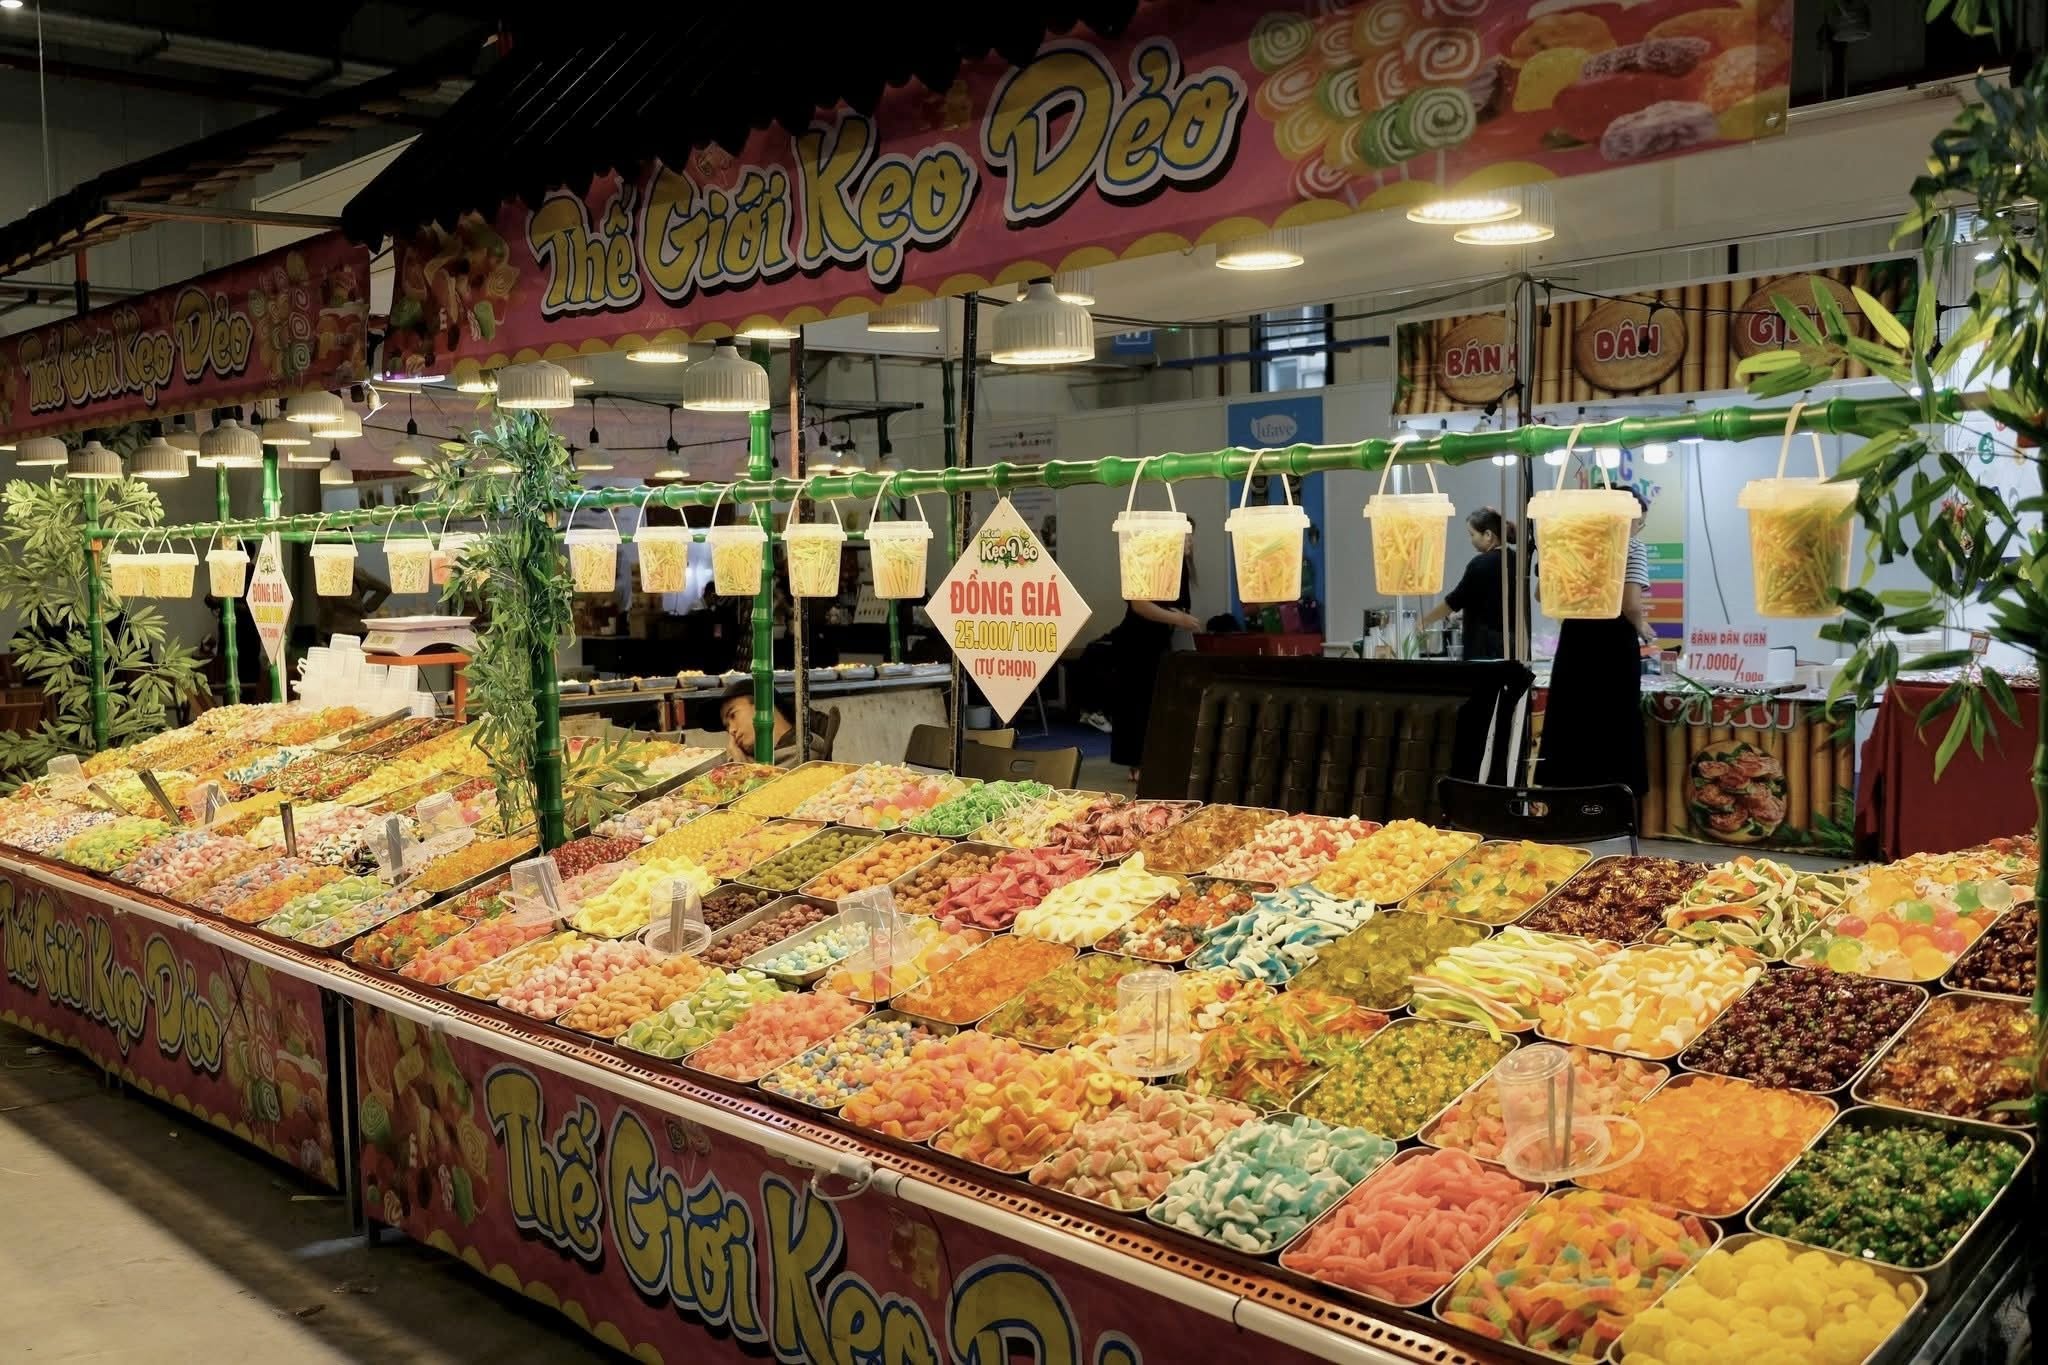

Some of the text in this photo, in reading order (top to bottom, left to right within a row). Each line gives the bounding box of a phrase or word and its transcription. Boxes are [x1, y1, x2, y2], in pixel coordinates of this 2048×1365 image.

[638, 158, 796, 302] Giới
[790, 112, 978, 286] Kẹo
[980, 36, 1248, 222] Dẻo
[174, 285, 254, 380] Dẻo
[1594, 318, 1660, 362] DÂN
[980, 535, 1039, 564] Kẹo Dẻo
[950, 569, 1061, 617] ĐỒNG GIÁ
[955, 619, 1057, 652] 25.000/100G
[974, 657, 1037, 681] (TỰ CHỌN)
[484, 1062, 602, 1262] Thế
[604, 1105, 768, 1344] Giới
